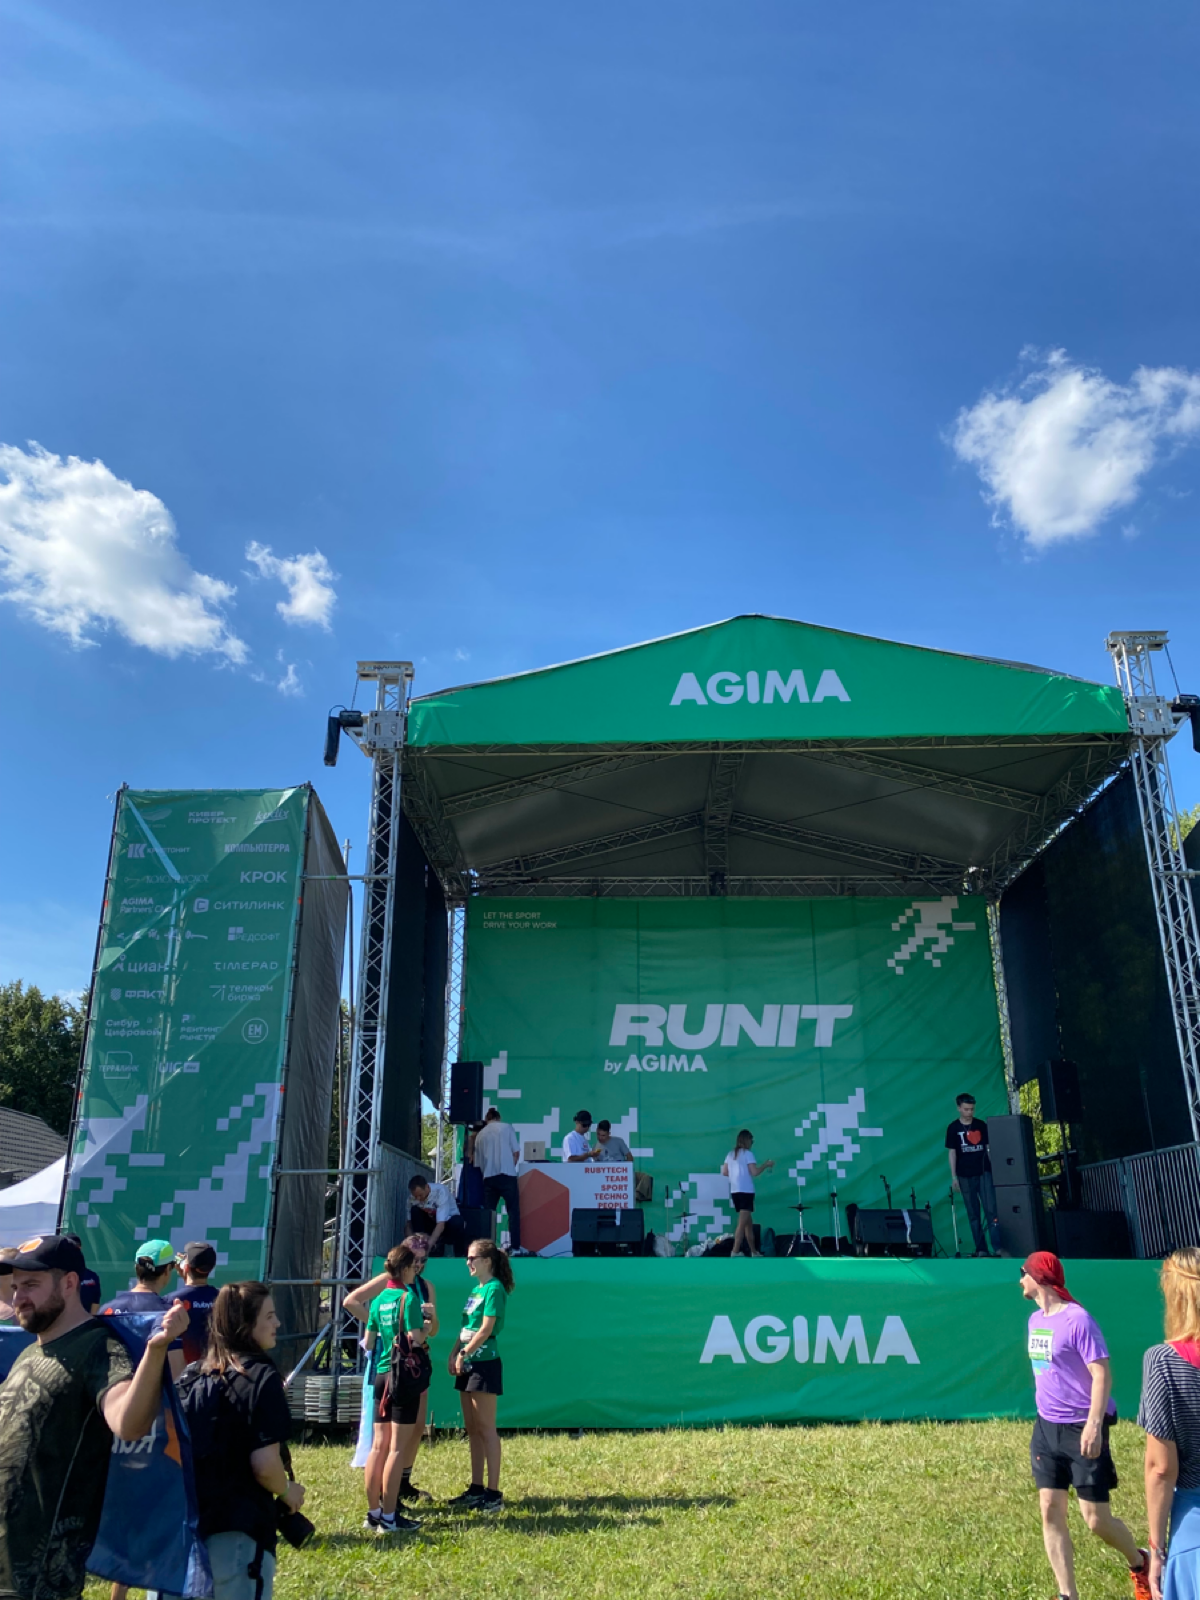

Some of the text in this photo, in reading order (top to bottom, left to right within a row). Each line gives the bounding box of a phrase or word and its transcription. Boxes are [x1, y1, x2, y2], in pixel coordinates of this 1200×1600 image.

[669, 669, 851, 706] AGIMA
[187, 816, 238, 824] ПРОТЕКТ
[223, 843, 290, 853] КОМПЬЮТЕРРА
[240, 871, 288, 884] КРОК
[121, 897, 154, 905] AGIMA
[213, 900, 285, 910] СИТИЛИНК
[234, 932, 281, 943] РЕДСОФТ
[213, 962, 279, 970] TIMEPAD
[125, 990, 165, 999] ФАКТ
[105, 1019, 140, 1028] Сибур
[609, 1004, 853, 1050] RUNIT
[104, 1028, 161, 1037] Цифровой
[603, 1054, 708, 1075] by AGIMA
[699, 1315, 921, 1364] AGIMA
